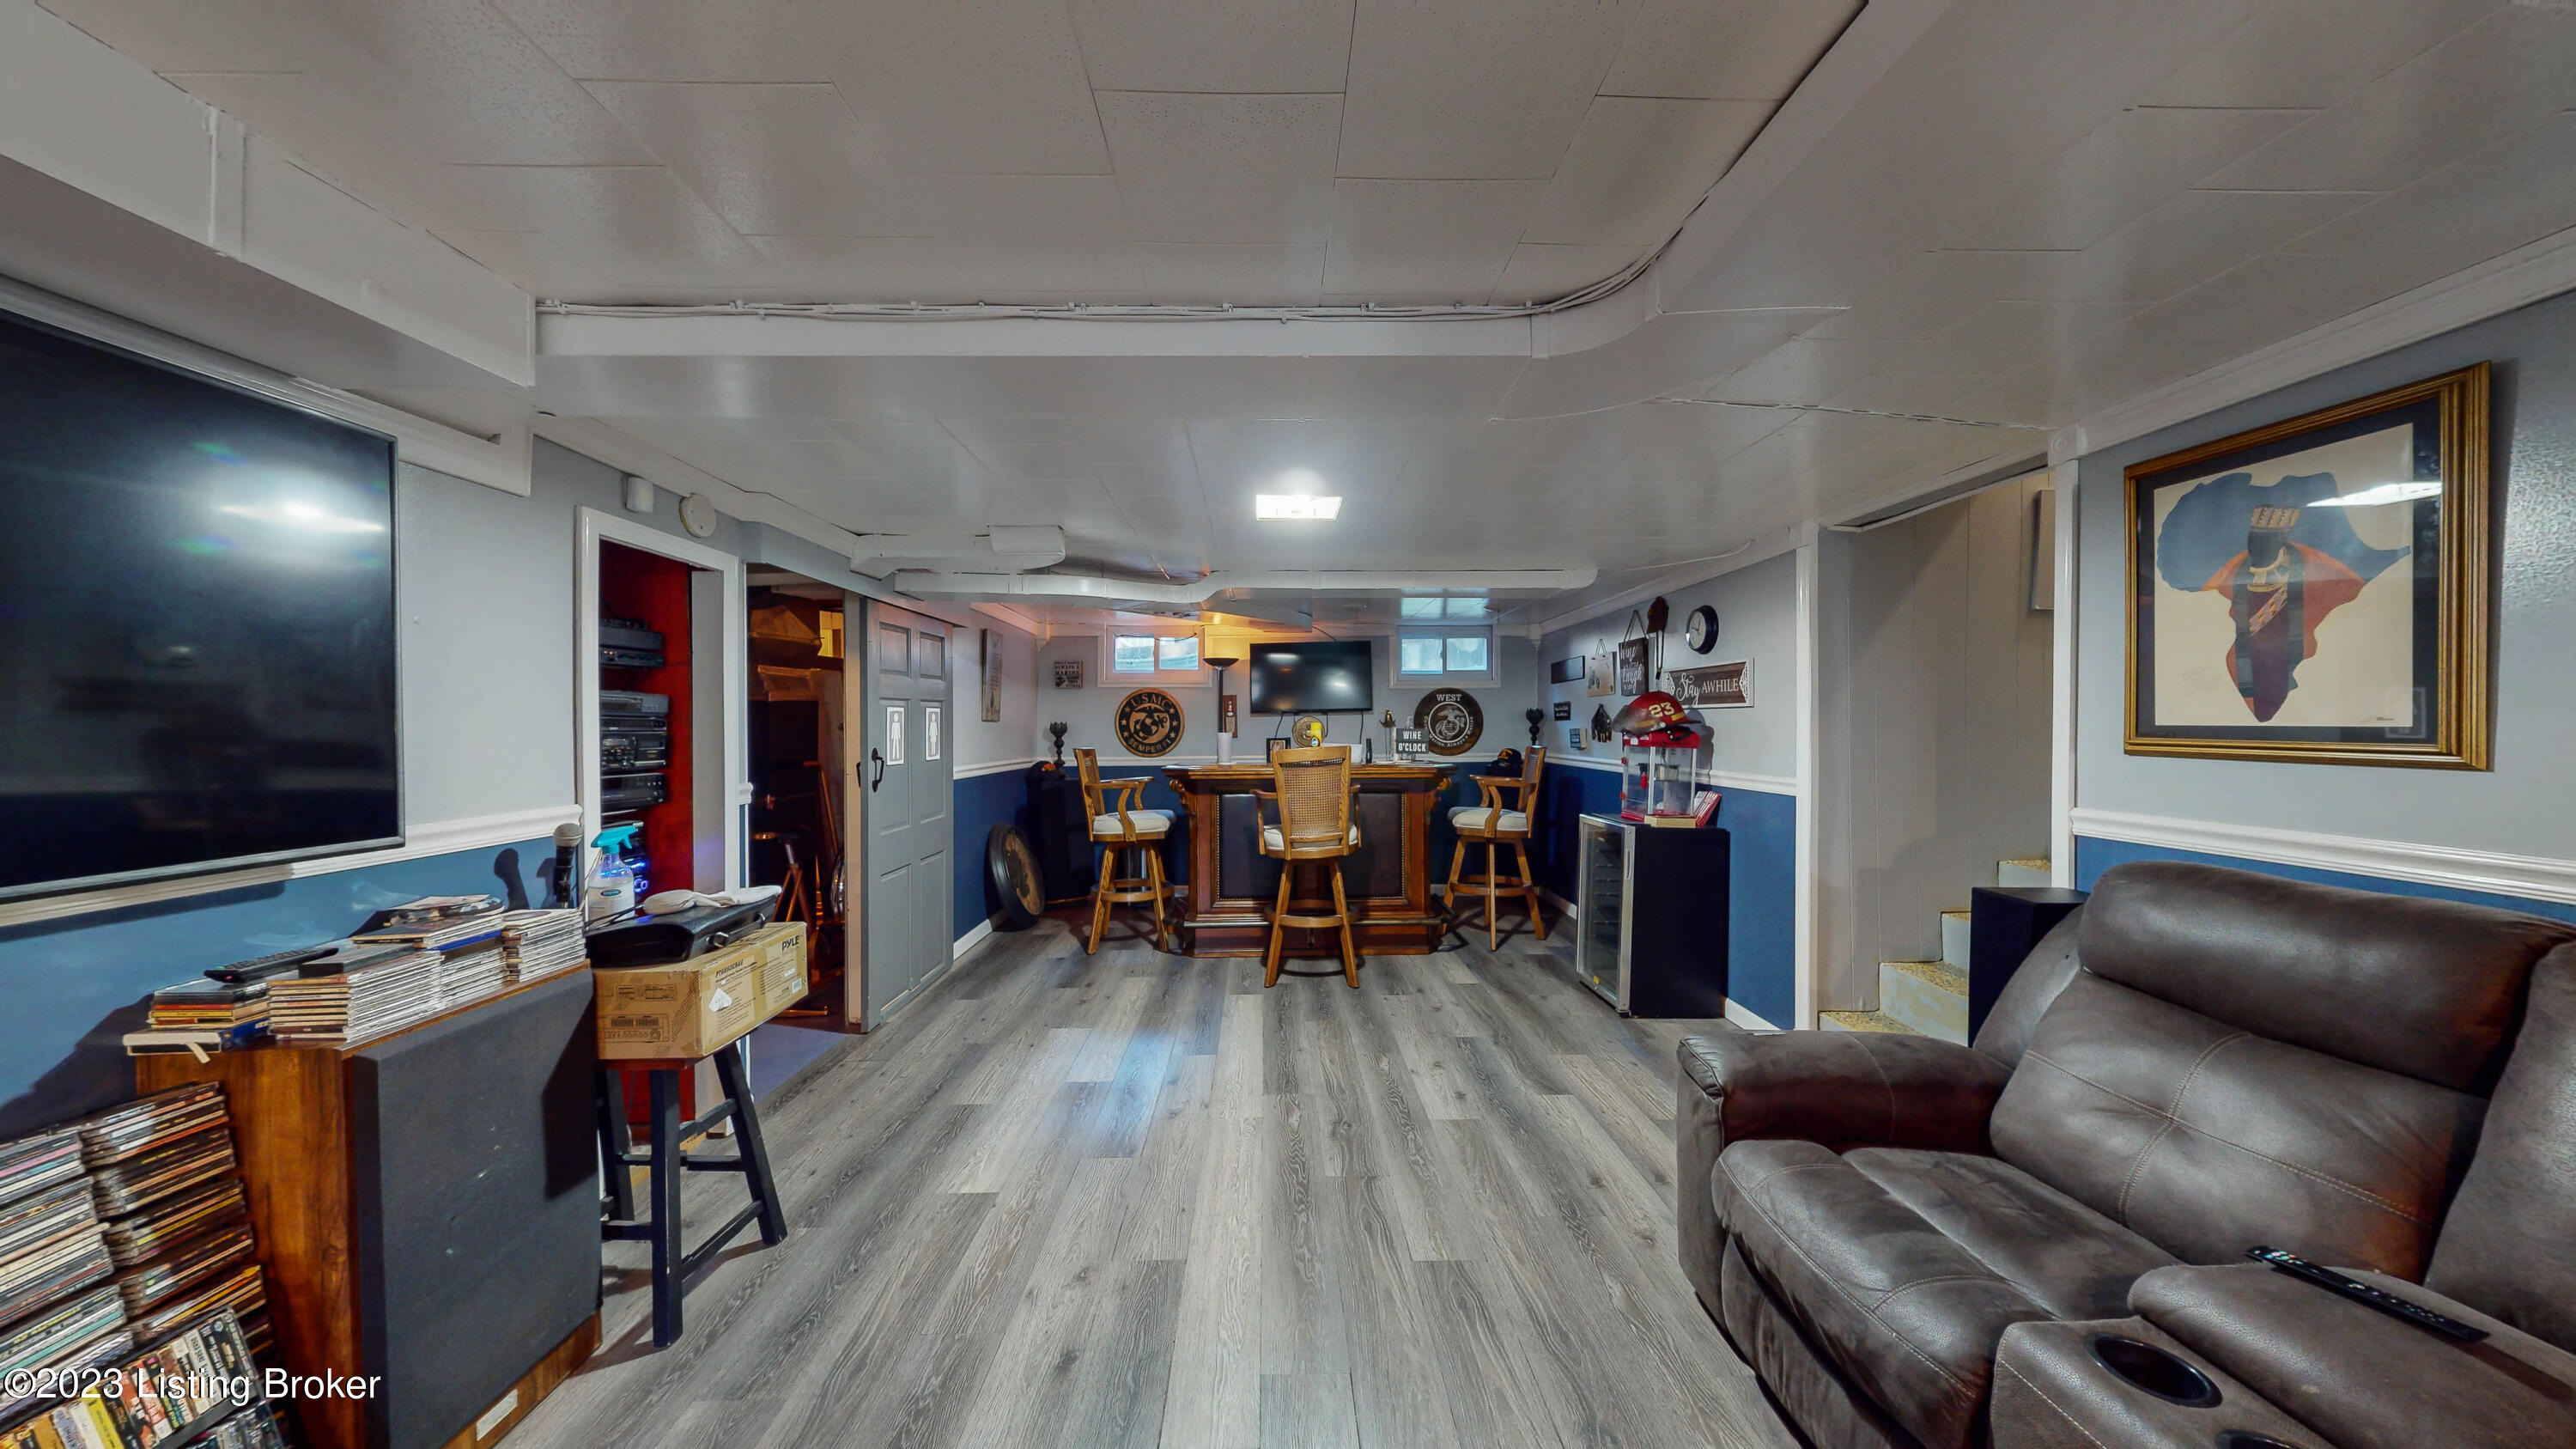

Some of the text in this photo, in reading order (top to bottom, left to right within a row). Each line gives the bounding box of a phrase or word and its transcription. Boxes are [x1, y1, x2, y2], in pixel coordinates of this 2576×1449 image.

[1436, 693, 1462, 702] WEST
[1675, 672, 1739, 708] Stay AWHILE
[1130, 693, 1172, 709] USMC
[1649, 702, 1675, 718] 23
[1403, 731, 1422, 740] WINE
[1127, 738, 1162, 753] SEMPER
[1398, 742, 1426, 752] O'CLOCK
[781, 935, 799, 952] PYLE
